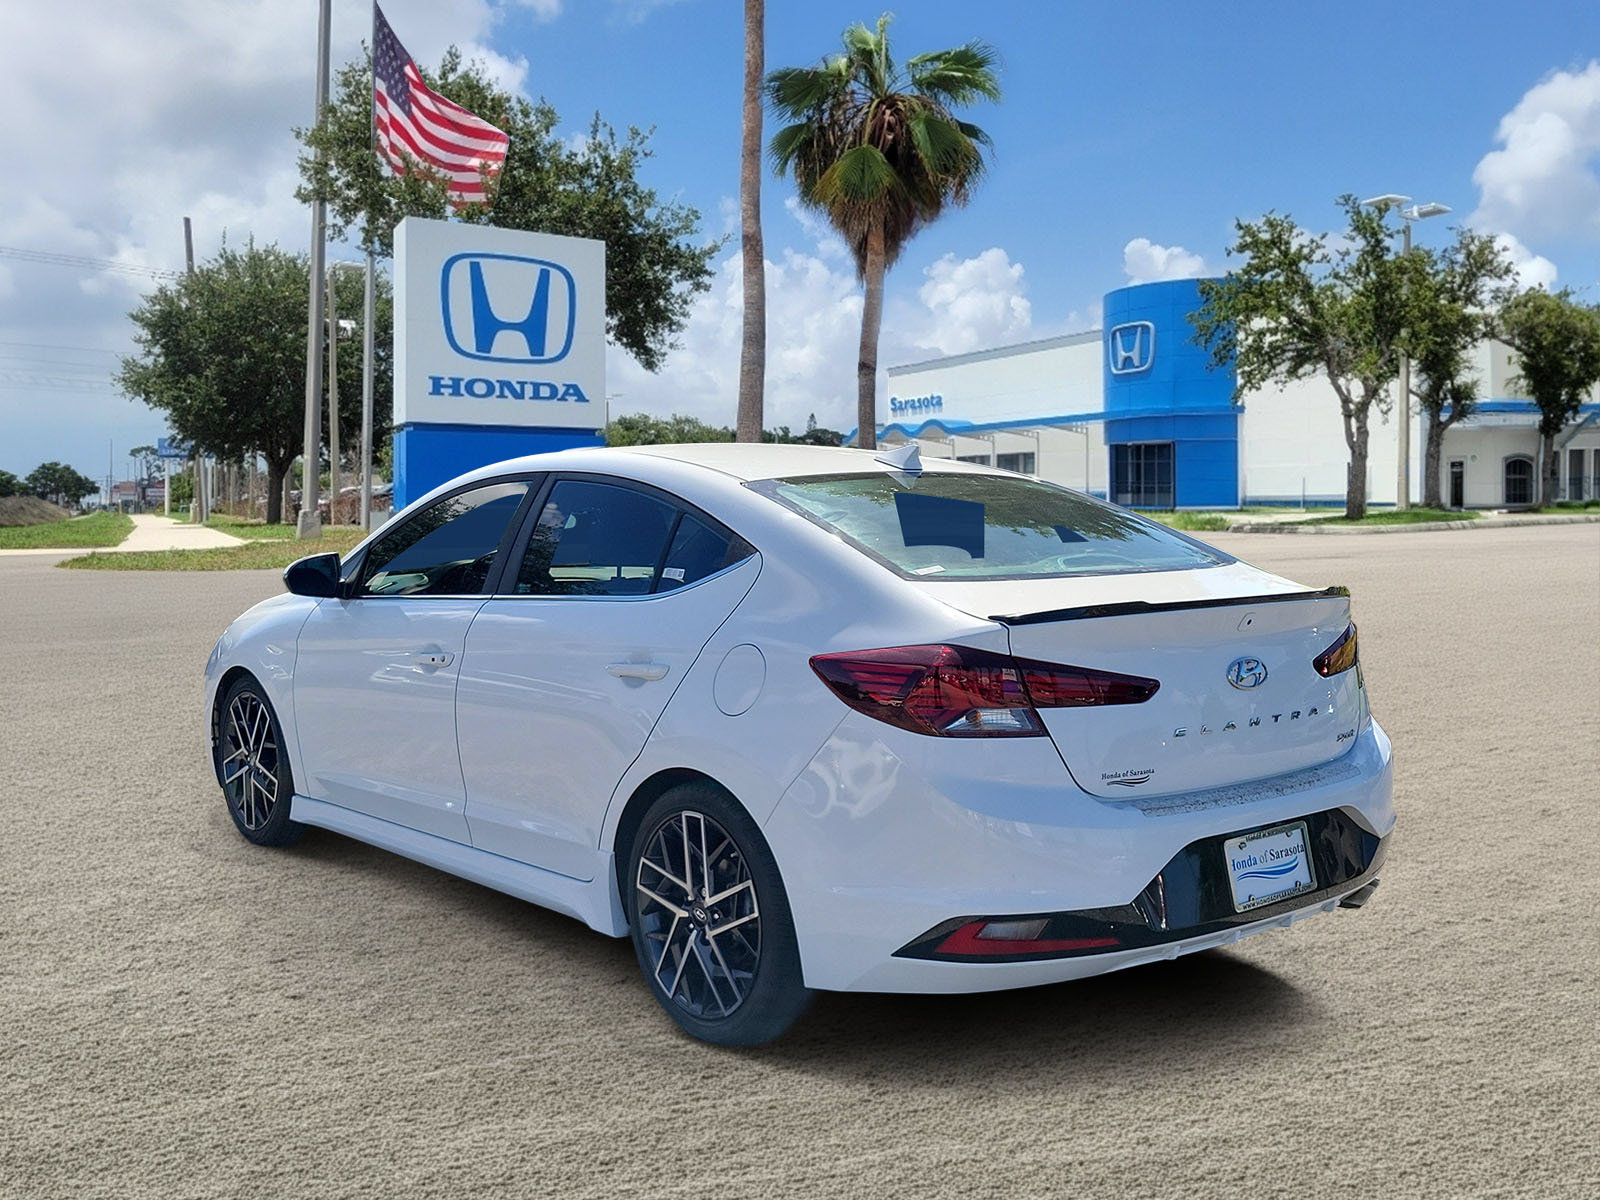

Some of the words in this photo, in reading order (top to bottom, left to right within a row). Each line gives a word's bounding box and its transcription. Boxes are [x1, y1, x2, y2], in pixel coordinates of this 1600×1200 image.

[428, 375, 590, 403] HONDA
[890, 393, 943, 412] Sarasota
[1173, 706, 1319, 738] ELANTRA
[1101, 771, 1121, 780] Honda
[1259, 848, 1268, 864] of
[1269, 843, 1305, 861] Sarasota
